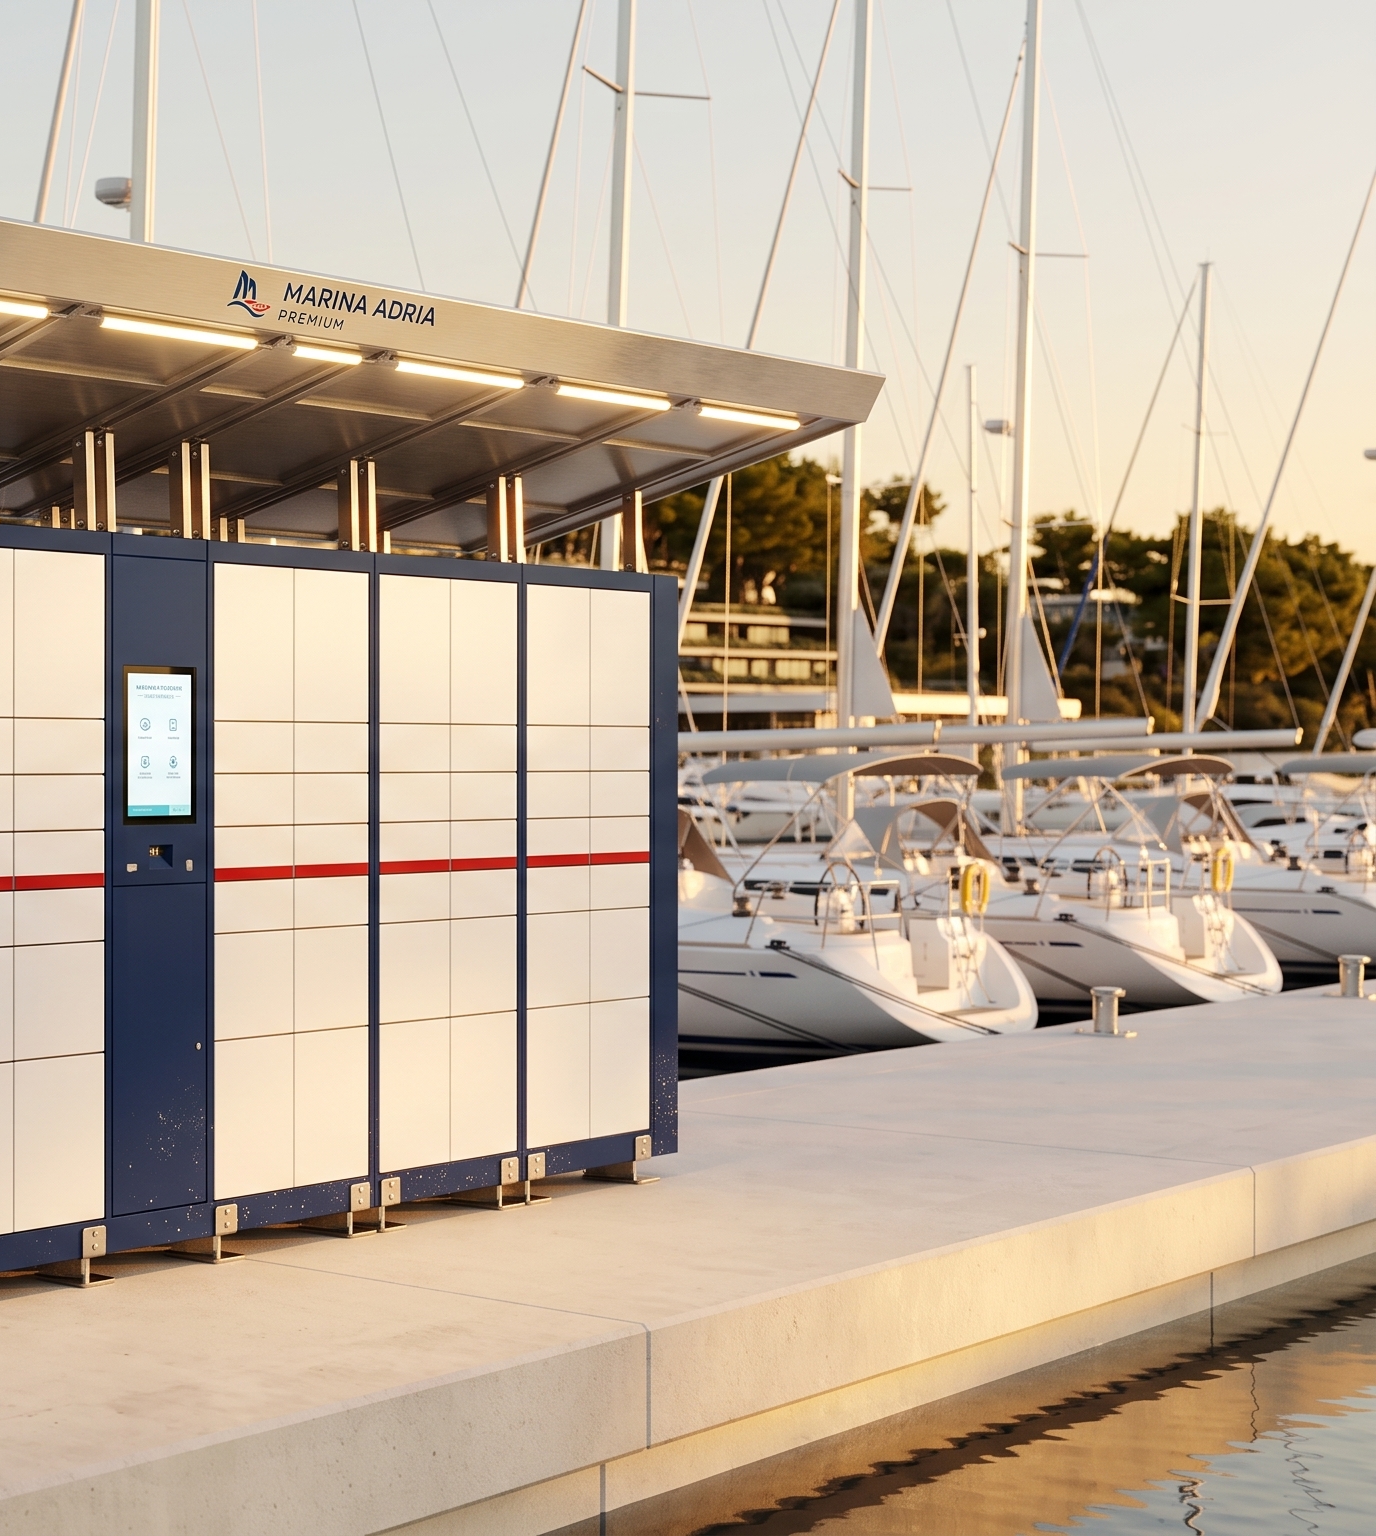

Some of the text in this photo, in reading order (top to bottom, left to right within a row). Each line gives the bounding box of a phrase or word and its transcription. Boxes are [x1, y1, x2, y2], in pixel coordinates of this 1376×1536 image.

[277, 309, 345, 331] PREMIUM
[283, 282, 436, 327] MARINA ADRIA
